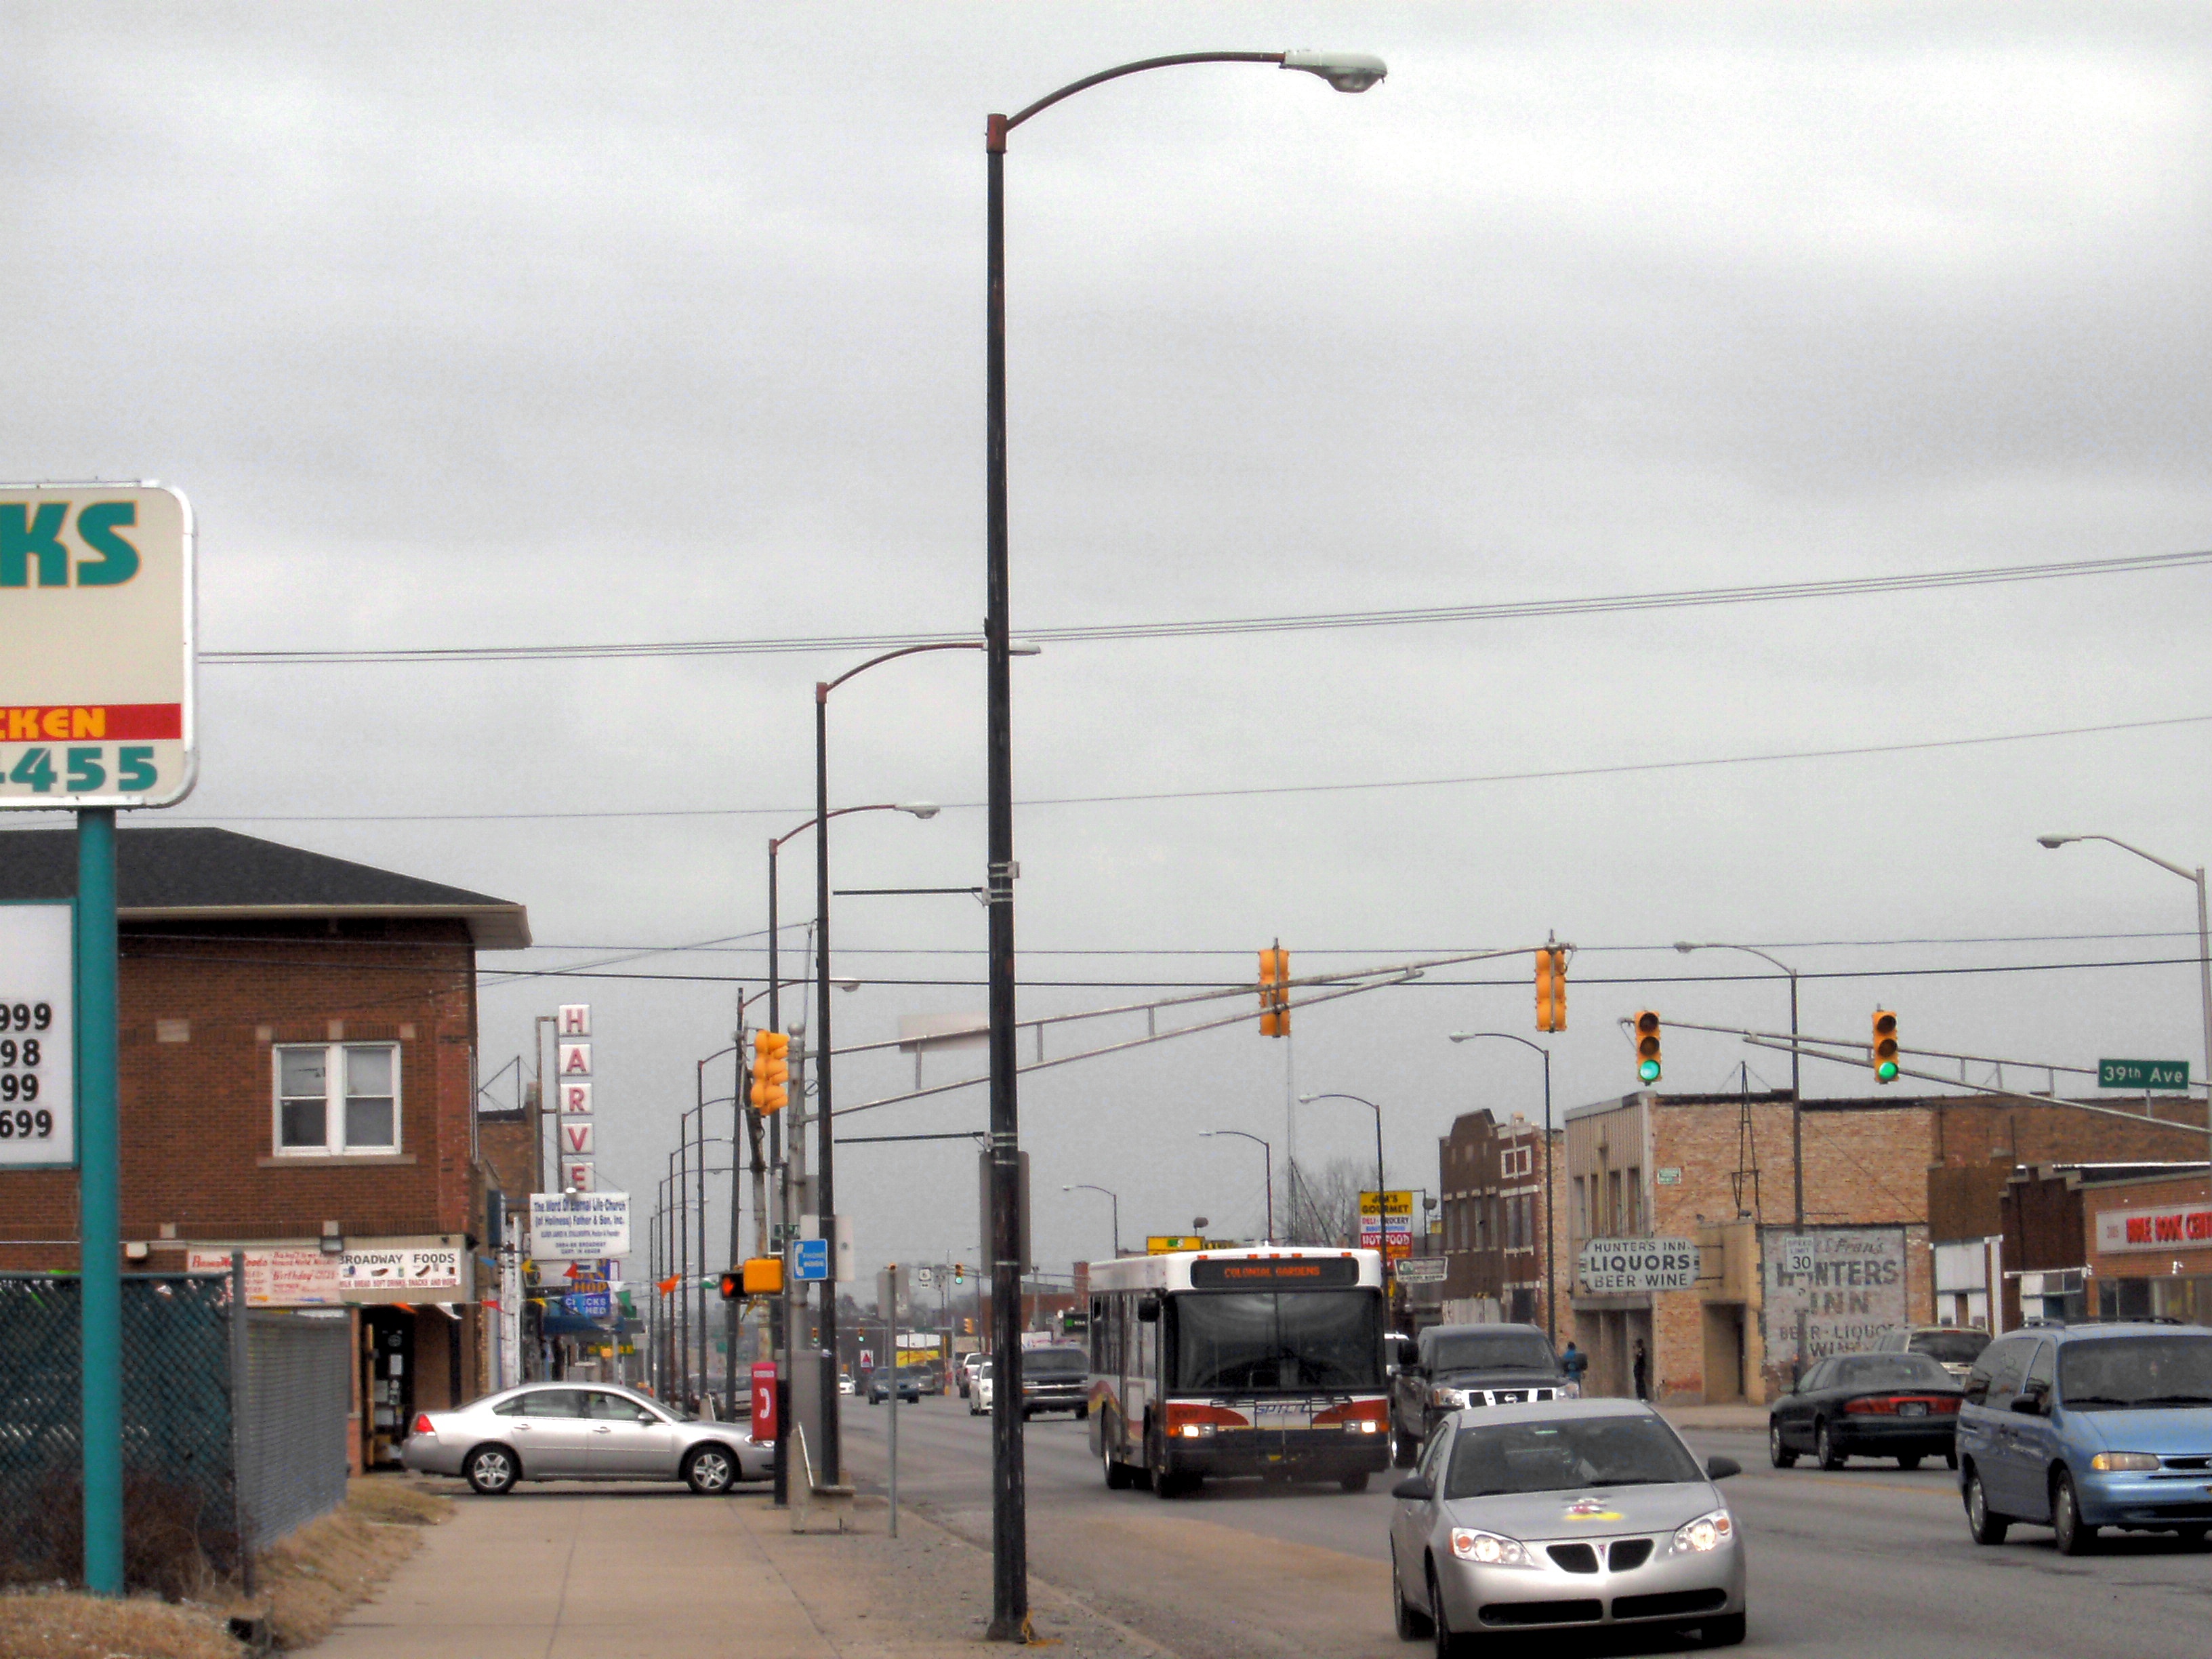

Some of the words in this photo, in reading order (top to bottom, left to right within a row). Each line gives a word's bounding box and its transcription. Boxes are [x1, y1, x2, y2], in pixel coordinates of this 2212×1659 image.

[0, 500, 143, 589] KS
[0, 707, 106, 739] KEN
[0, 746, 158, 792] 455
[0, 1038, 41, 1067] 98
[2104, 1066, 2141, 1082] 39th
[2150, 1067, 2183, 1082] Ave
[0, 1073, 39, 1102] 99
[1362, 1235, 1381, 1245] HOT
[1386, 1234, 1410, 1245] FOOD
[1595, 1242, 1656, 1252] HUNTER'S
[413, 1253, 455, 1263] FOODS
[1591, 1254, 1689, 1272] LIQUORS
[1793, 1256, 1811, 1269] 30
[1224, 1267, 1272, 1278] COLONIAL
[1275, 1265, 1320, 1277] GARDENS
[1776, 1259, 1899, 1287] HNTERS
[1810, 1291, 1869, 1315] INN
[1780, 1325, 1821, 1340] BER
